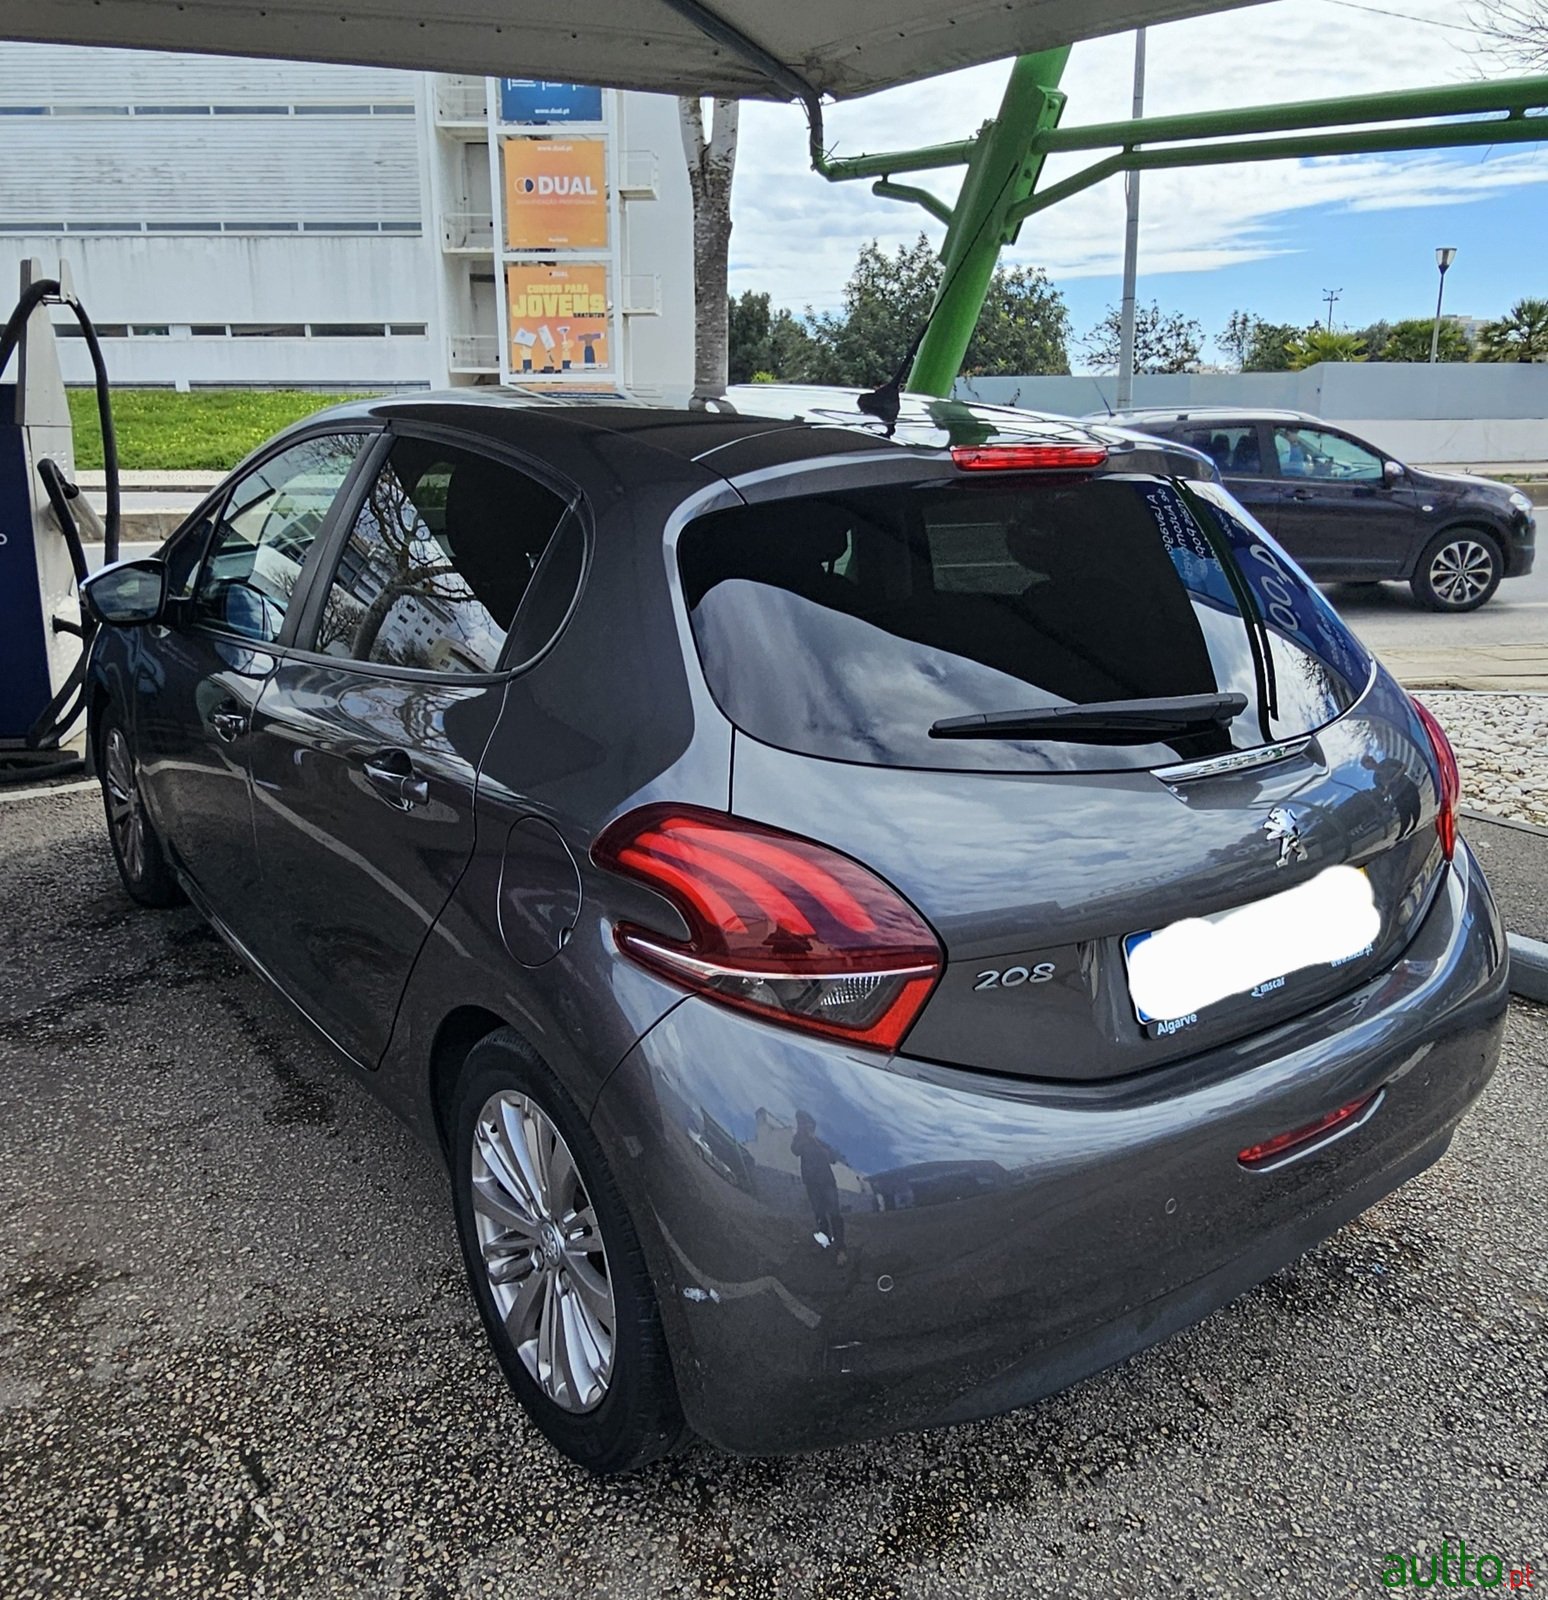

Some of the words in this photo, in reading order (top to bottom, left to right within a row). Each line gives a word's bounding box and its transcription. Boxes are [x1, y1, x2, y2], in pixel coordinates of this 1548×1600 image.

[538, 176, 598, 195] DUAL
[564, 283, 589, 293] PARA
[512, 294, 605, 318] JOVENS
[974, 962, 1056, 991] 208
[1156, 1013, 1198, 1036] Algarve
